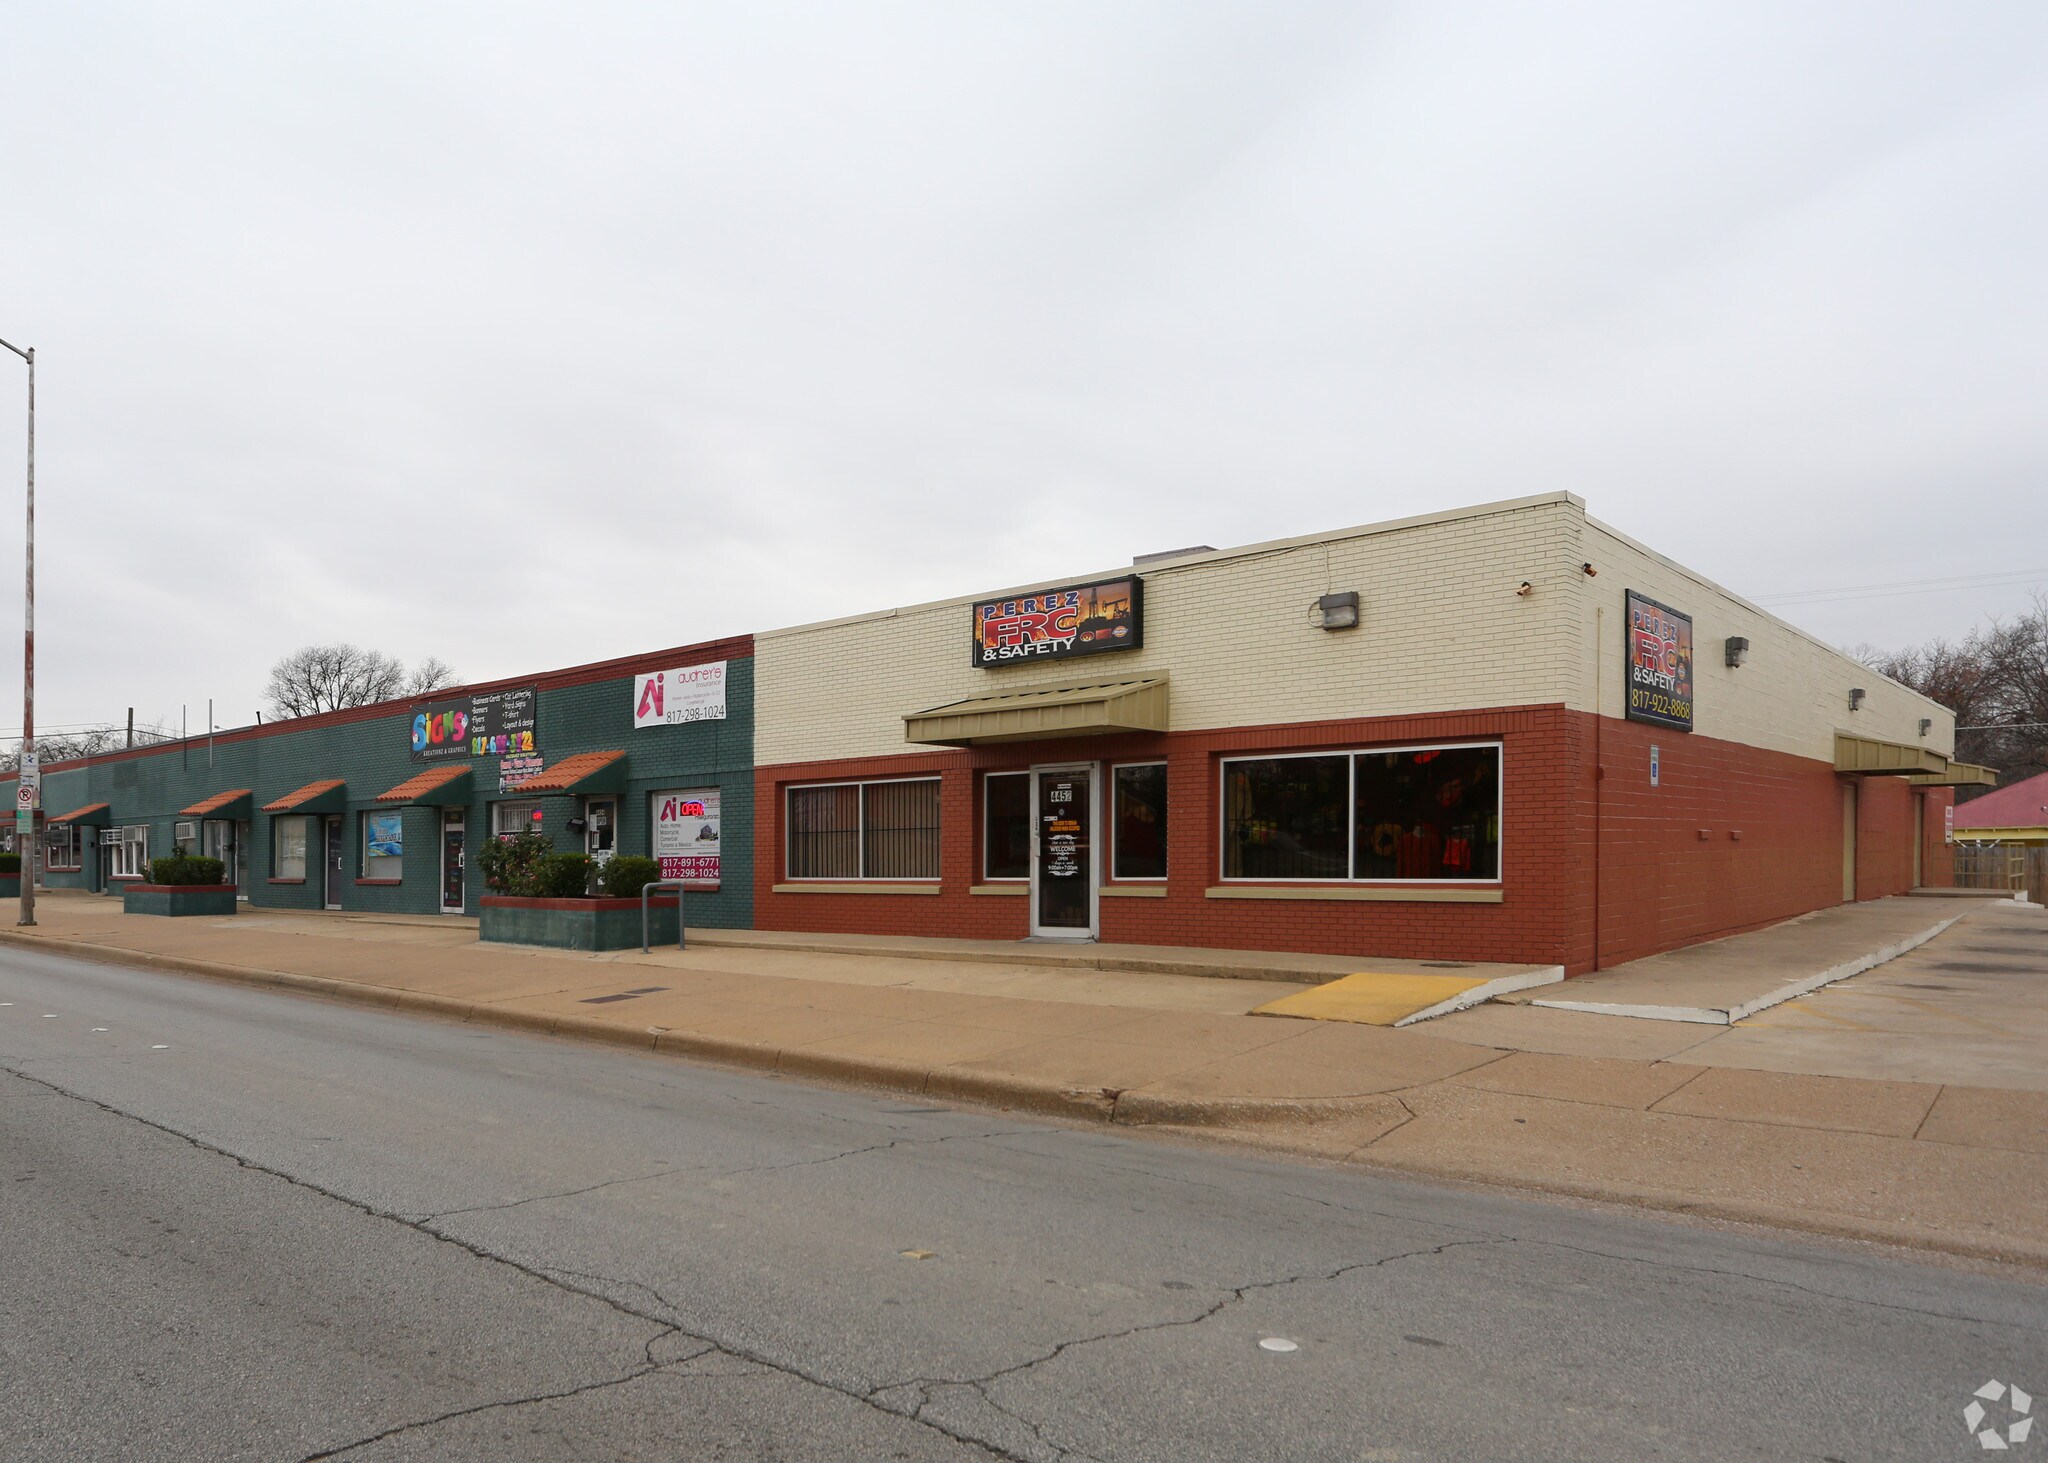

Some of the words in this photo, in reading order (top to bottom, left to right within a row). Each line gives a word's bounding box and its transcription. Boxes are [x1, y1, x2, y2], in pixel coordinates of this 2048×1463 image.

[983, 590, 1079, 620] PEREZ
[983, 606, 1078, 650] FRC
[1634, 609, 1677, 642] PEREZ
[982, 649, 997, 661] &
[998, 637, 1076, 659] SAFETY
[1634, 628, 1676, 678] FRC
[1633, 667, 1642, 682] &
[1642, 669, 1676, 692] SAFETY
[666, 704, 725, 723] 817-298-1024
[1632, 689, 1691, 719] 817-922-8868
[681, 803, 703, 816] OPEN
[661, 868, 719, 878] 817-298-1024
[662, 858, 719, 867] 817-891-6771
